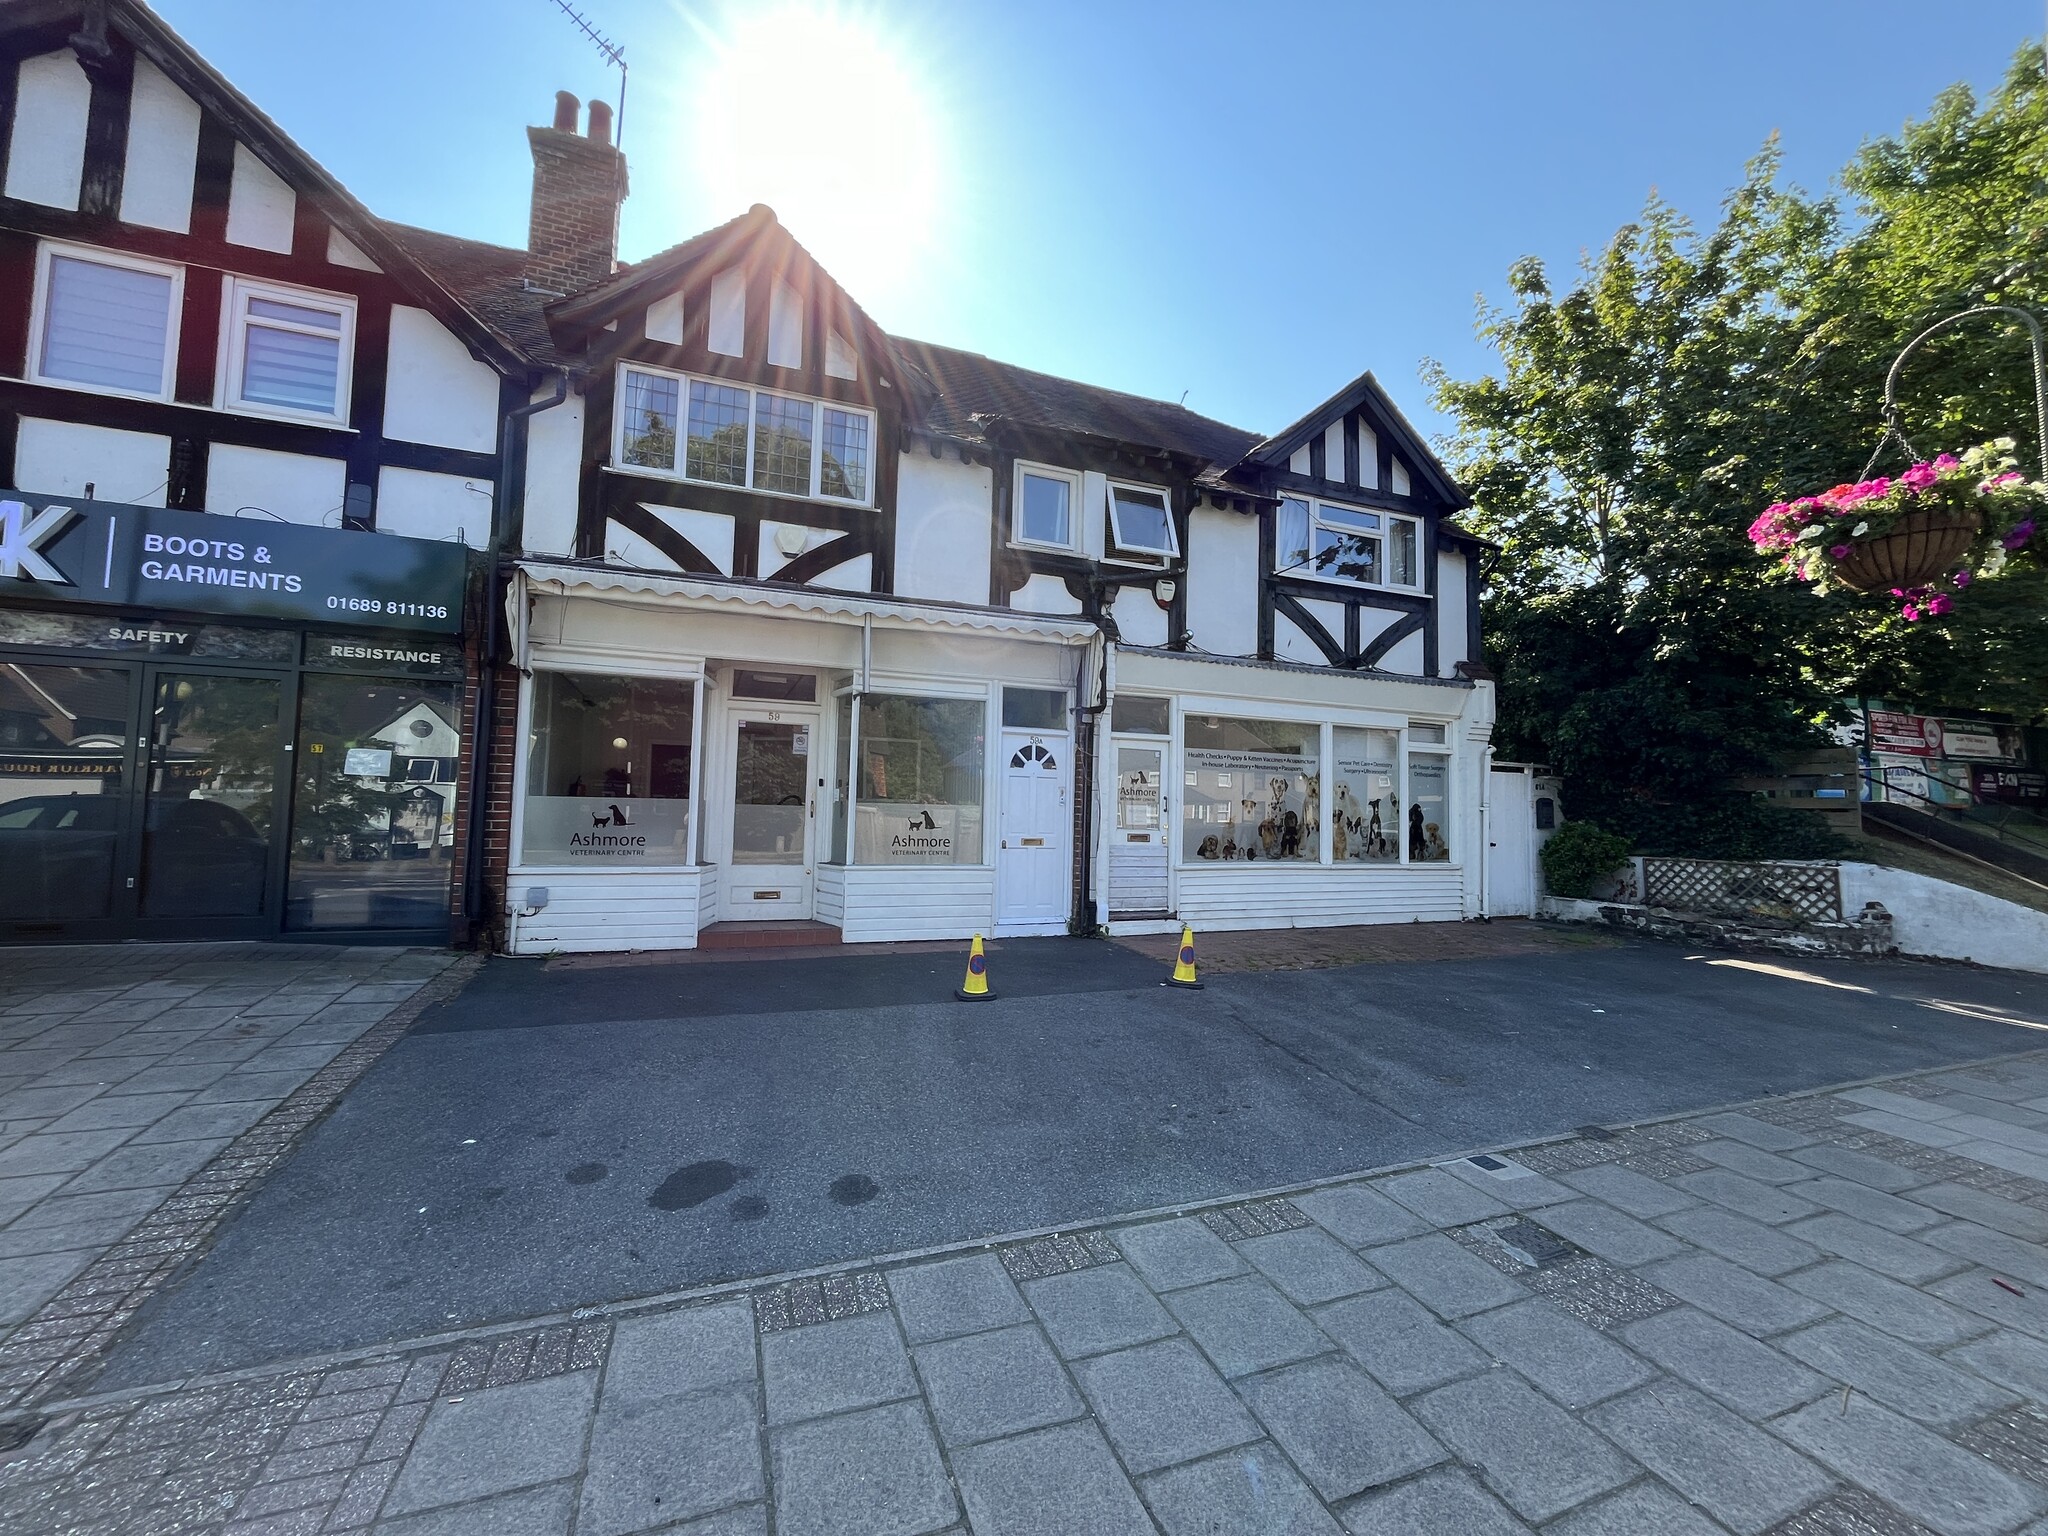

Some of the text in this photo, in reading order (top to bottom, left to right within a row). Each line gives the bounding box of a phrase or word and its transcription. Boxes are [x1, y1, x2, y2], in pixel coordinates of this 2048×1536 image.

[144, 533, 272, 564] BOOTS &
[141, 561, 302, 593] GARMENTS
[327, 596, 447, 619] 01689 811136
[108, 627, 188, 644] SAFETY
[331, 645, 441, 664] RESISTANCE
[768, 712, 780, 721] 59
[1030, 736, 1043, 745] 59A
[1120, 787, 1157, 797] Ashmore
[570, 832, 646, 846] Ashmore
[891, 834, 951, 847] Ashmore
